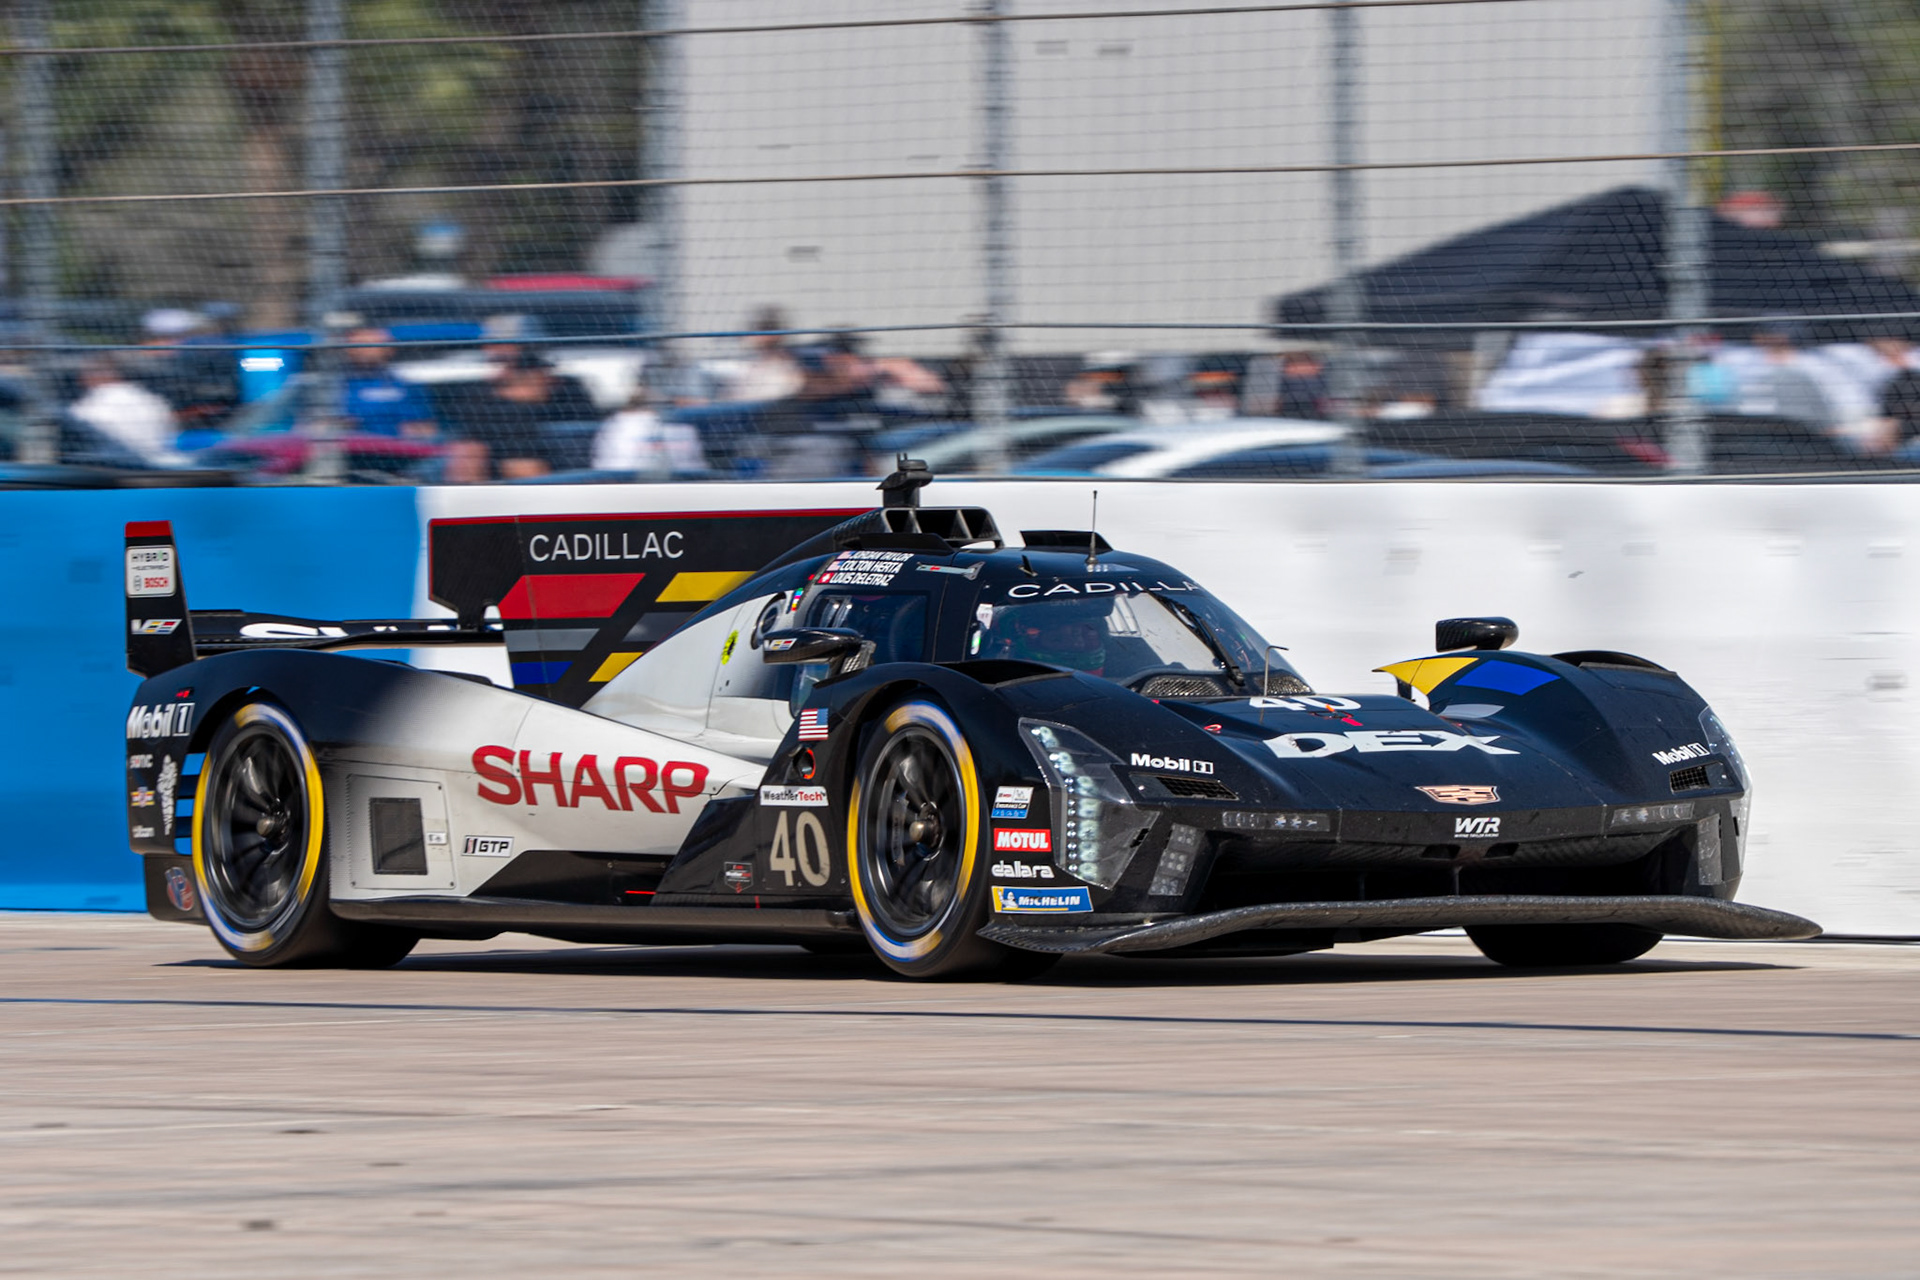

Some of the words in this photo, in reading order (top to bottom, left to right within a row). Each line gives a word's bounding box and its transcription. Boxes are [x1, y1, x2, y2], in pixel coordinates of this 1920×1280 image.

[529, 531, 683, 562] CADILLAC
[131, 551, 169, 562] HYBRID
[839, 560, 876, 572] COLTON
[870, 561, 904, 574] HERTA
[144, 577, 169, 588] BOSCH
[829, 572, 855, 584] LOUIS
[1249, 696, 1361, 711] 40
[126, 703, 176, 739] Mobil
[1262, 730, 1521, 758] DEX
[1130, 752, 1191, 771] Mobil
[1652, 745, 1697, 765] Mobil
[471, 745, 709, 814] SHARP
[763, 789, 823, 801] WeatherTech
[1455, 817, 1501, 833] WTR
[479, 840, 509, 853] GTP
[769, 810, 830, 887] 40
[997, 832, 1048, 849] MOTUL
[991, 860, 1054, 879] dallara
[1018, 895, 1080, 906] MICHELIN
